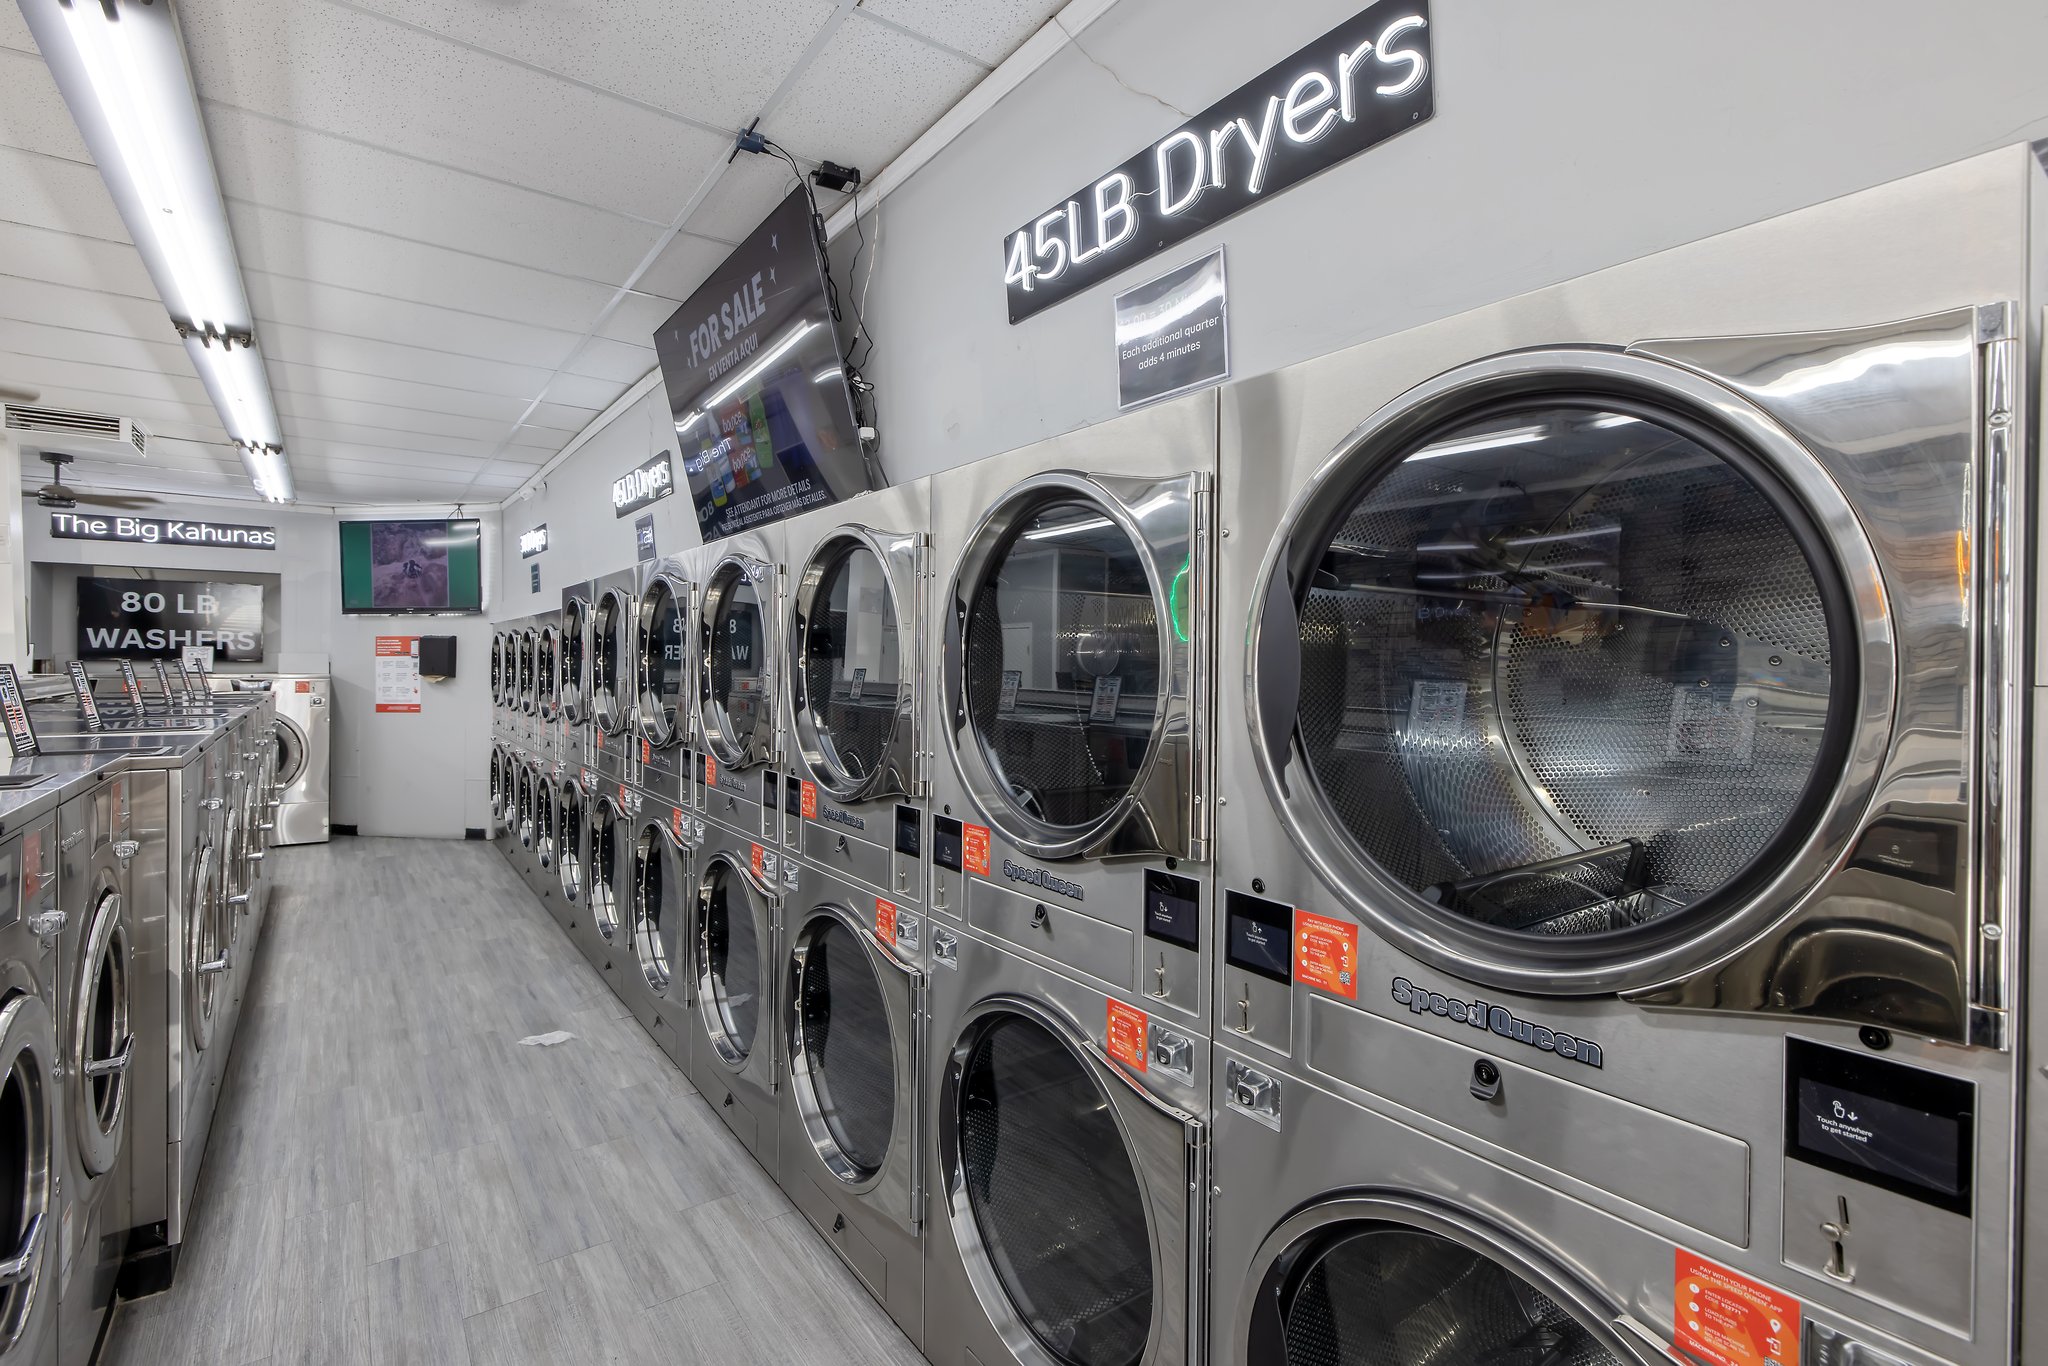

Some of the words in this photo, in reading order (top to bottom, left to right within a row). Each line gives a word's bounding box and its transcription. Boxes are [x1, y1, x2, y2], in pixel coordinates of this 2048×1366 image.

[1003, 172, 1139, 291] 45LB
[1156, 14, 1428, 216] Dryers
[689, 313, 722, 368] FOR
[721, 271, 766, 341] SALE
[1122, 343, 1141, 360] Each
[1142, 331, 1183, 353] additional
[1184, 315, 1220, 338] quarter
[708, 364, 718, 382] EN
[716, 347, 740, 374] VENTA
[1138, 354, 1158, 370] adds
[1159, 352, 1165, 362] 4
[1166, 341, 1201, 360] minutes
[723, 411, 742, 433] bounce
[732, 447, 751, 472] bounce
[635, 461, 670, 499] Dryers
[725, 507, 734, 518] SEE
[733, 497, 761, 517] ATTENDANT
[760, 493, 772, 507] FOR
[771, 487, 788, 503] MORE
[788, 479, 811, 499] DETAILS
[52, 513, 107, 535] The
[117, 518, 159, 543] Big
[168, 521, 276, 545] Kahunas
[121, 591, 166, 614] 80
[177, 593, 217, 615] LB
[86, 627, 256, 651] WASHERS
[1003, 859, 1042, 887] Speed
[1041, 869, 1084, 901] Queen
[1391, 976, 1488, 1031] Speed
[1488, 1004, 1603, 1069] Queen
[1816, 1114, 1837, 1126] Touch
[1838, 1123, 1873, 1138] anywhere
[1830, 1127, 1841, 1135] get
[1842, 1130, 1867, 1143] started
[1689, 1267, 1709, 1281] USING
[1710, 1276, 1722, 1286] THE
[1723, 1282, 1743, 1296] SPEED
[1769, 1303, 1783, 1313] APP
[1699, 1265, 1712, 1275] PAY
[1712, 1271, 1729, 1282] WITH
[1729, 1279, 1748, 1290] YOUR
[1748, 1287, 1772, 1302] PHONE
[1704, 1289, 1721, 1300] ENTER
[1721, 1297, 1749, 1314] LOCATION
[1704, 1307, 1719, 1317] LOAD
[1719, 1314, 1737, 1327] FUNDS
[1704, 1312, 1713, 1320] TO
[1712, 1315, 1723, 1324] THE
[1704, 1325, 1721, 1337] ENTER
[1688, 1339, 1715, 1356] MACHINE
